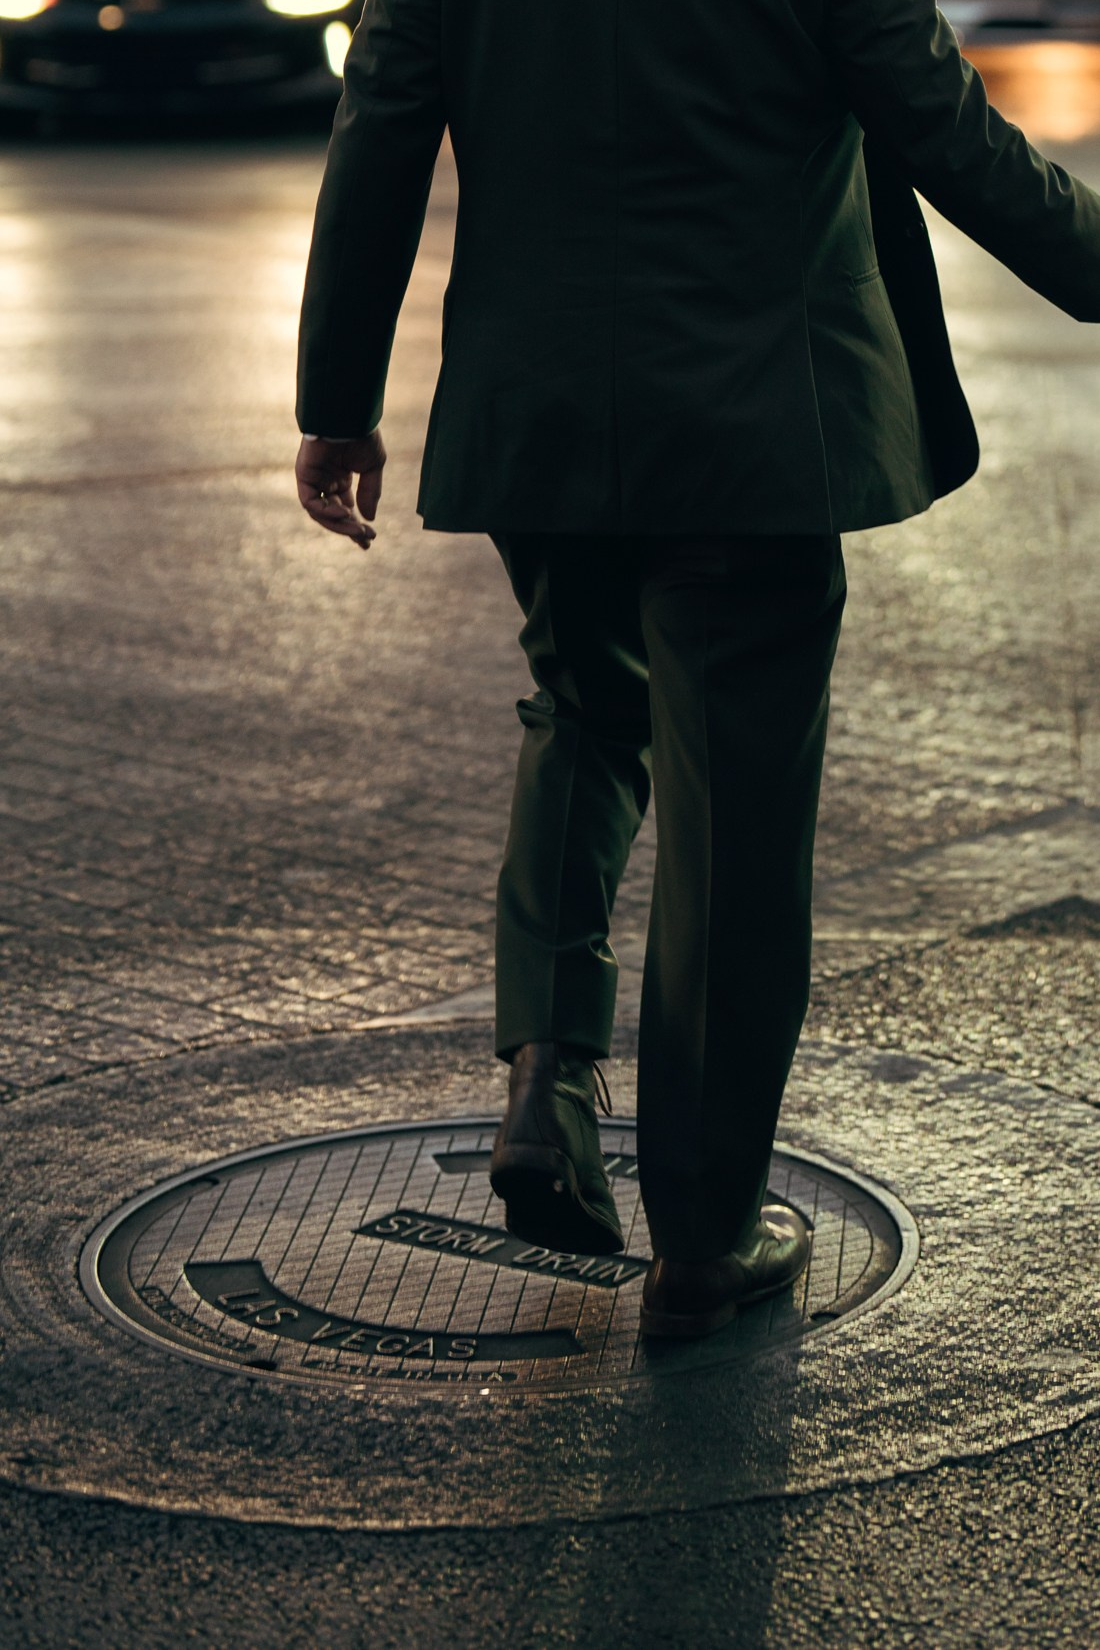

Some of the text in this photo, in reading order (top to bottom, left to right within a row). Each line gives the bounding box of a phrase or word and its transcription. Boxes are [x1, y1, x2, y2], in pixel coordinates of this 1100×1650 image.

[374, 1213, 640, 1285] STORM DRAIN
[216, 1286, 299, 1327] LAS
[309, 1320, 479, 1360] VEGAS
